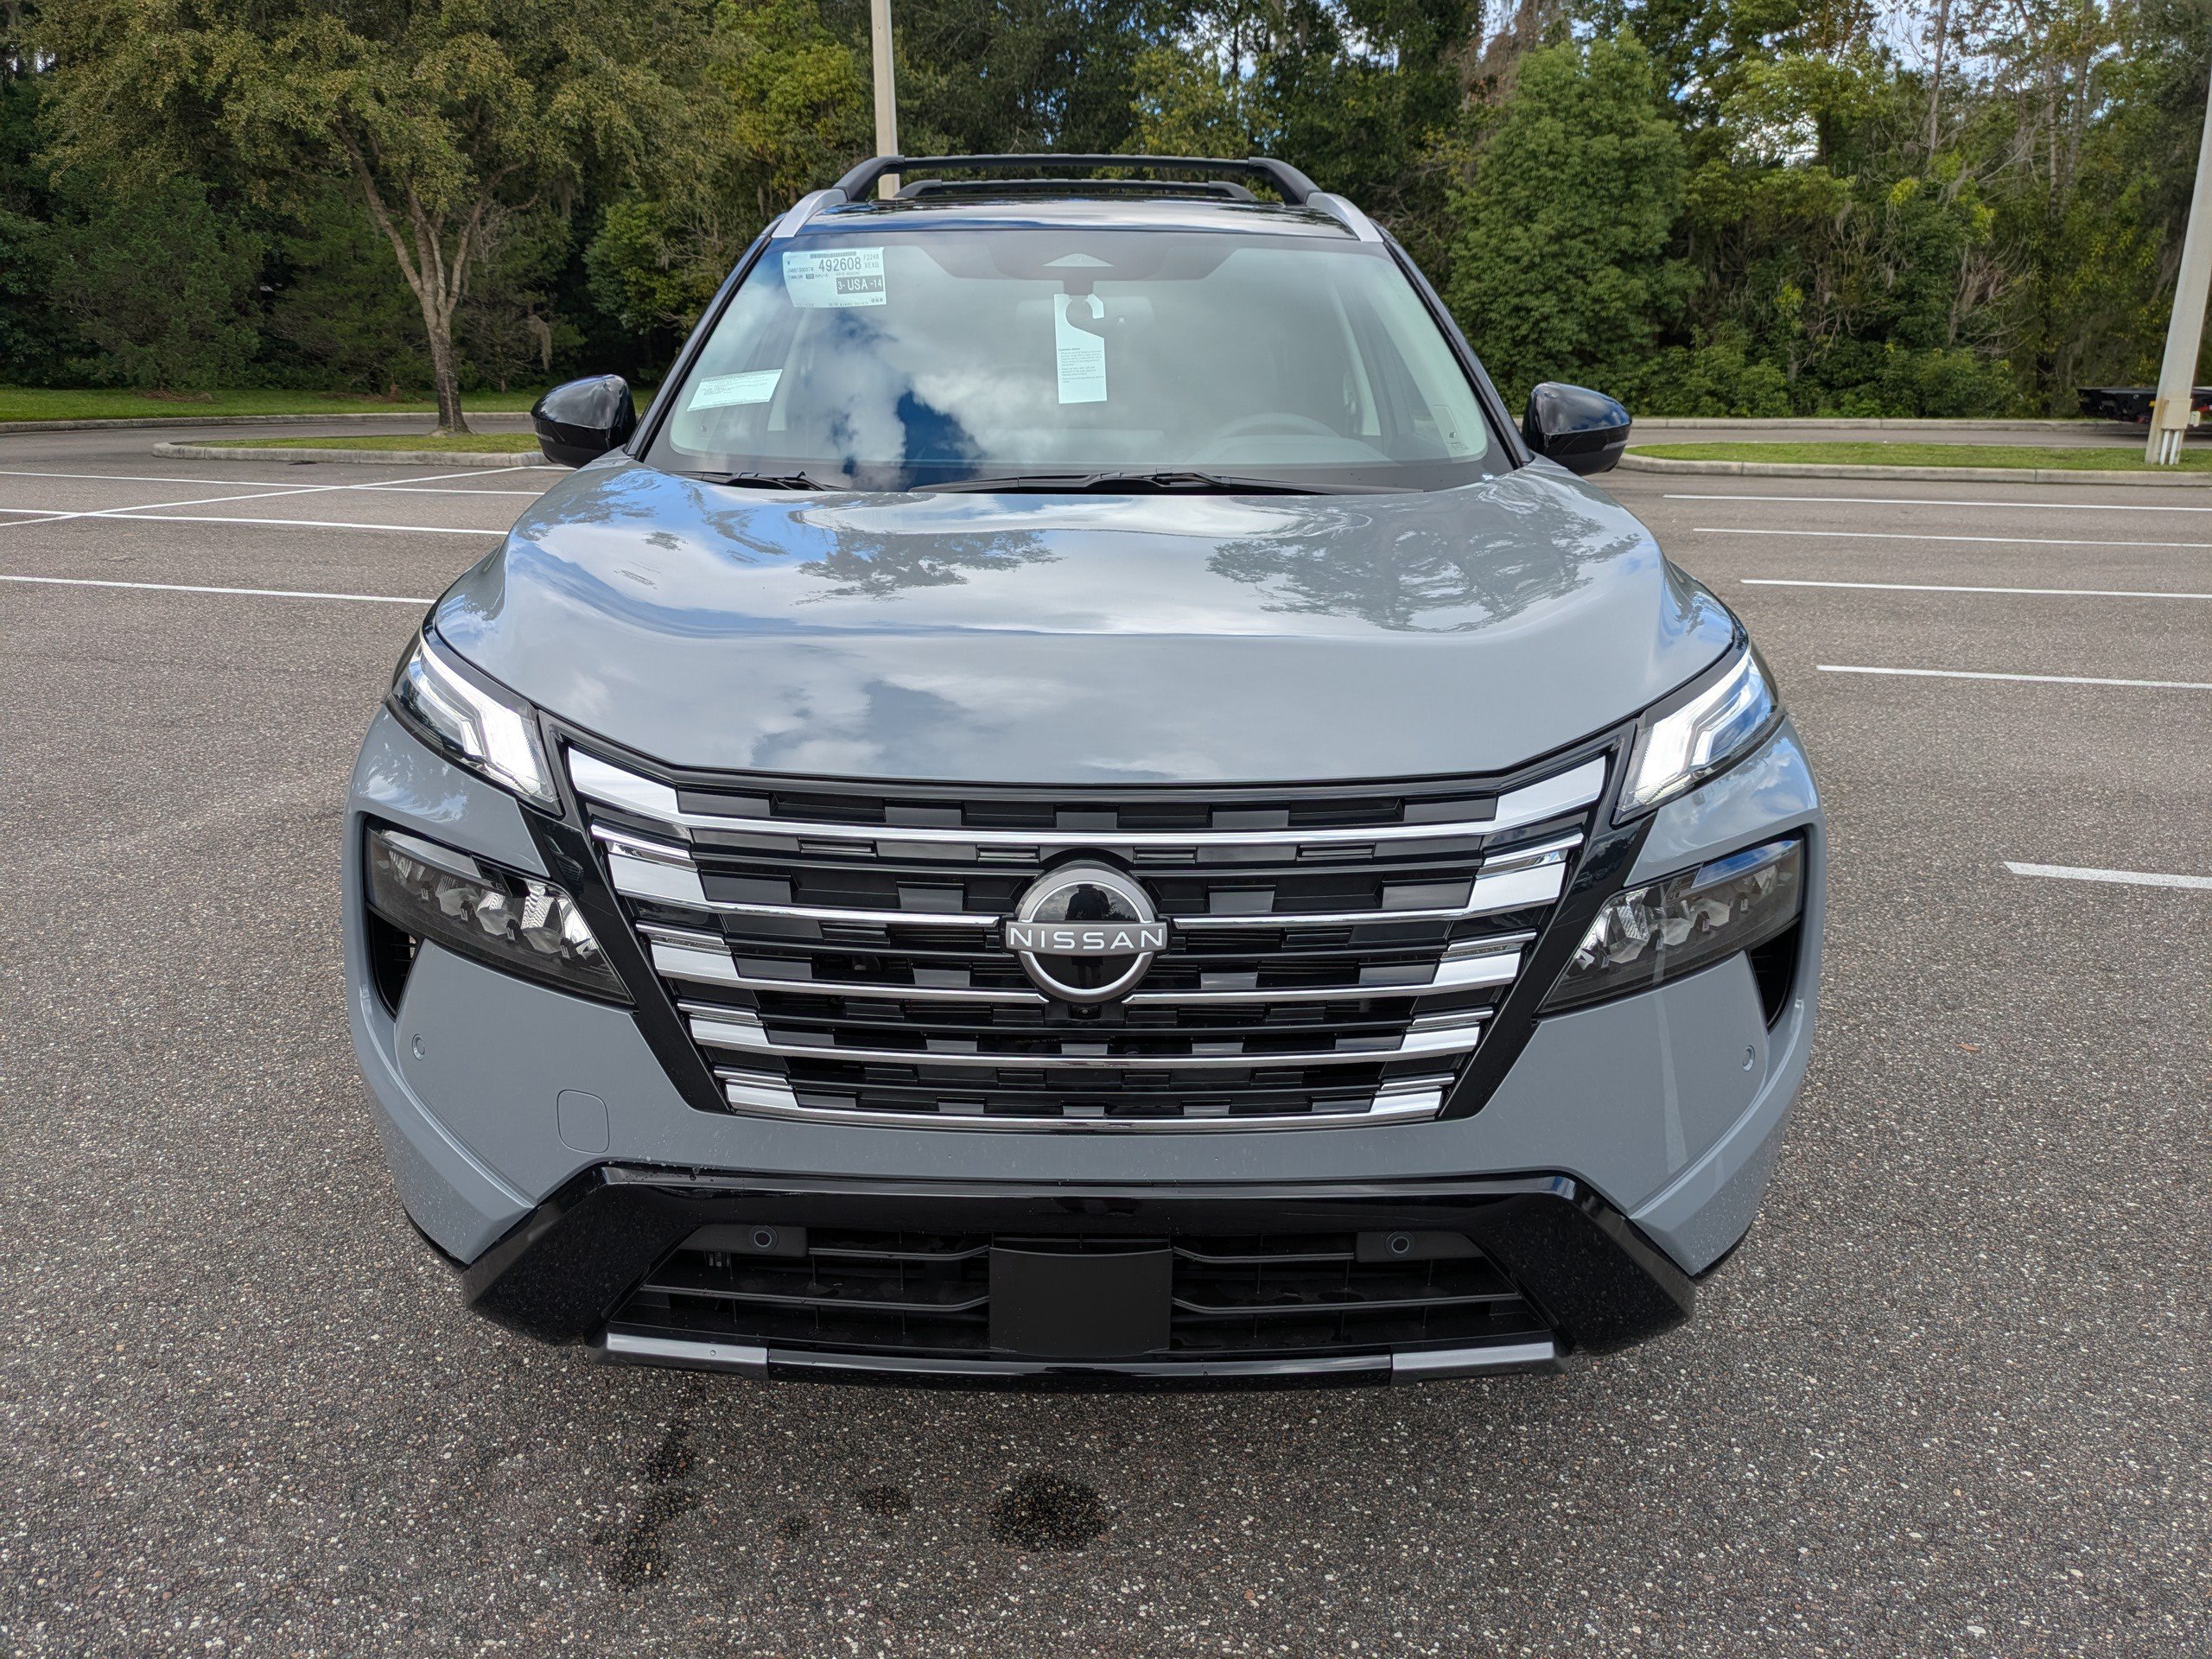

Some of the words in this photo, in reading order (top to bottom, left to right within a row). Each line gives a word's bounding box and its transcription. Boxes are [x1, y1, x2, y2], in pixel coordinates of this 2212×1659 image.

[818, 257, 861, 272] 492608
[847, 278, 868, 291] USA
[1010, 927, 1162, 950] NISSAN
